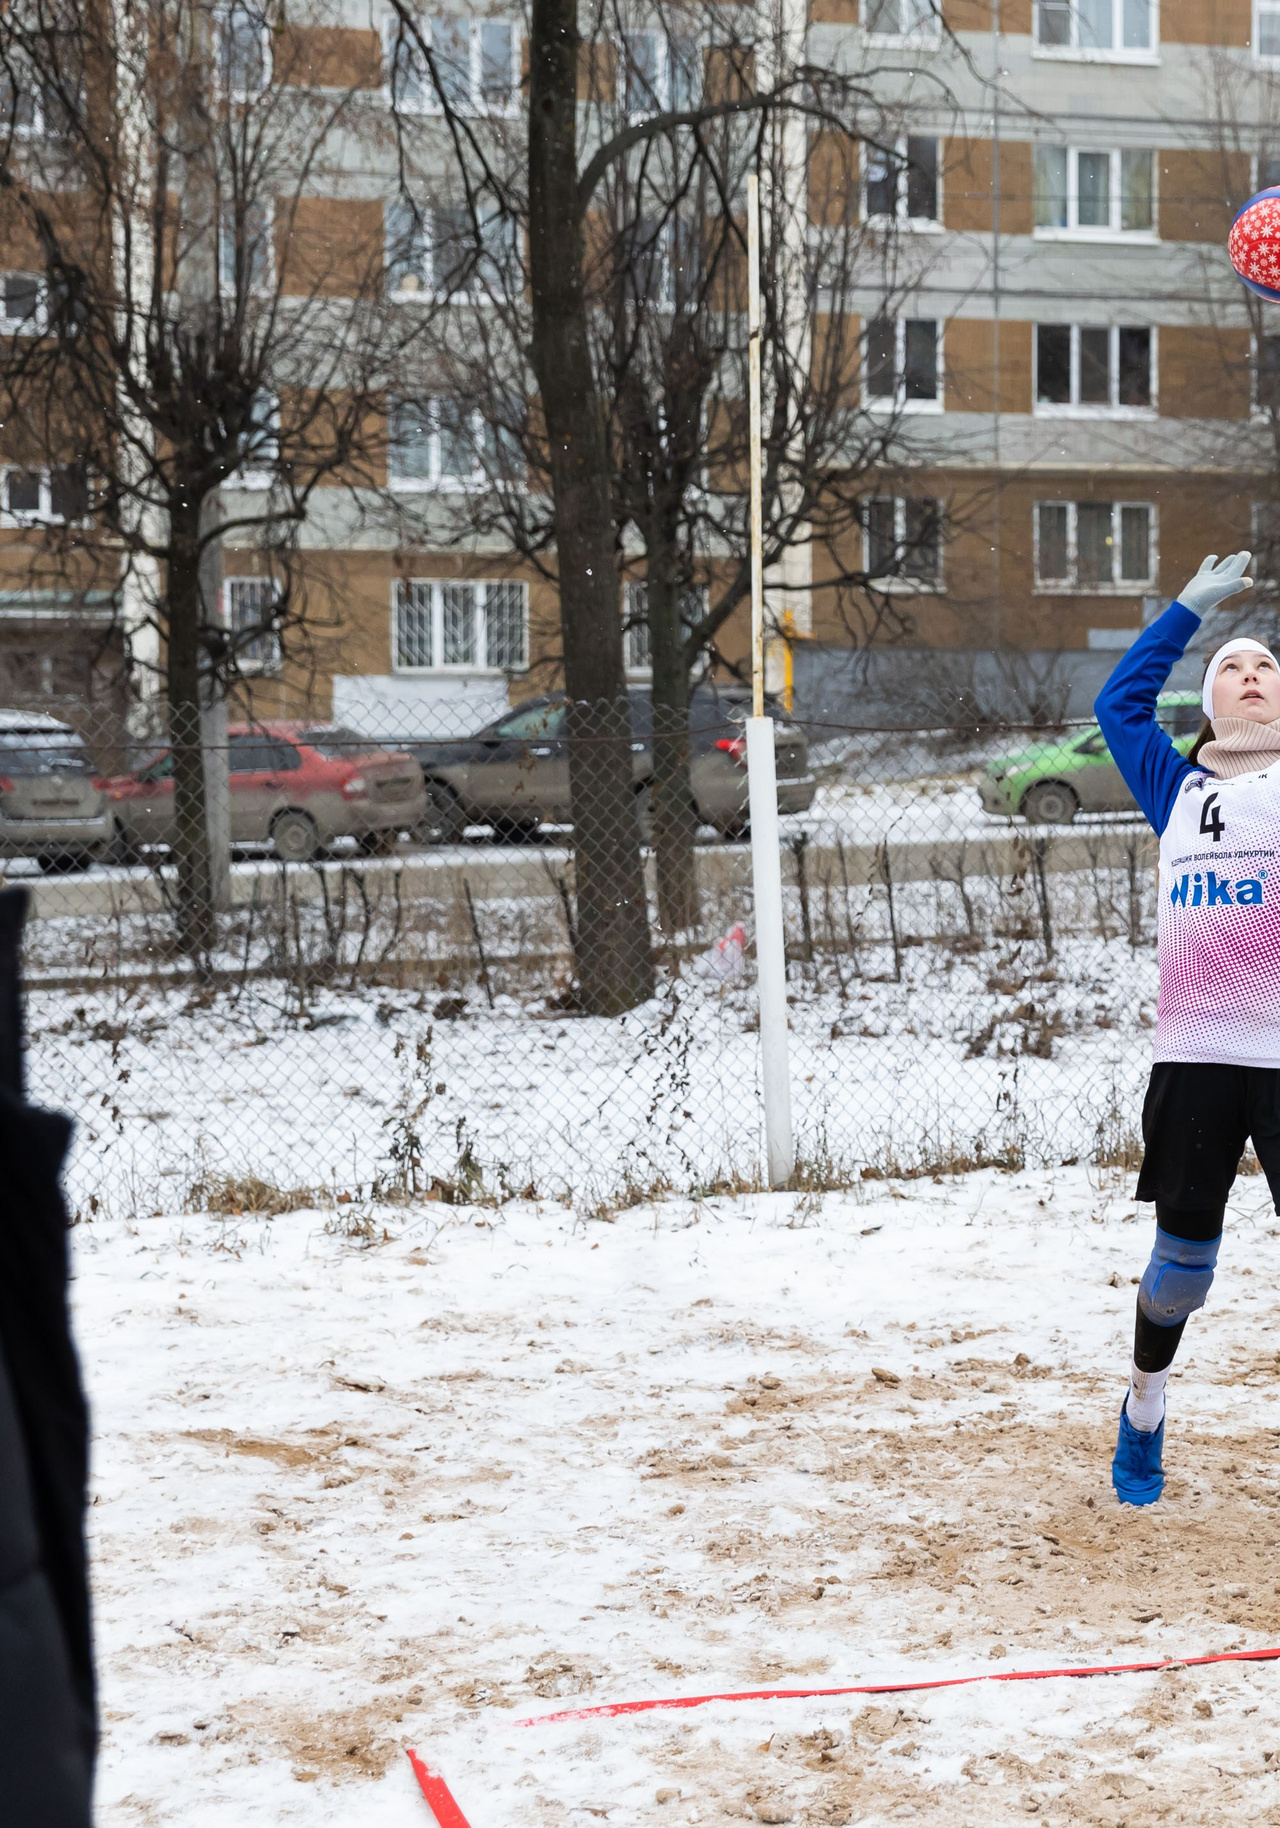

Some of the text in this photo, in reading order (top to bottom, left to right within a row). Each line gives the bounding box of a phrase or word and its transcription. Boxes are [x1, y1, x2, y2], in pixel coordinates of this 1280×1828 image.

[1199, 791, 1225, 842] 4
[1193, 849, 1275, 861] ВОЛЕЙБОЛА УДМУРТИИ
